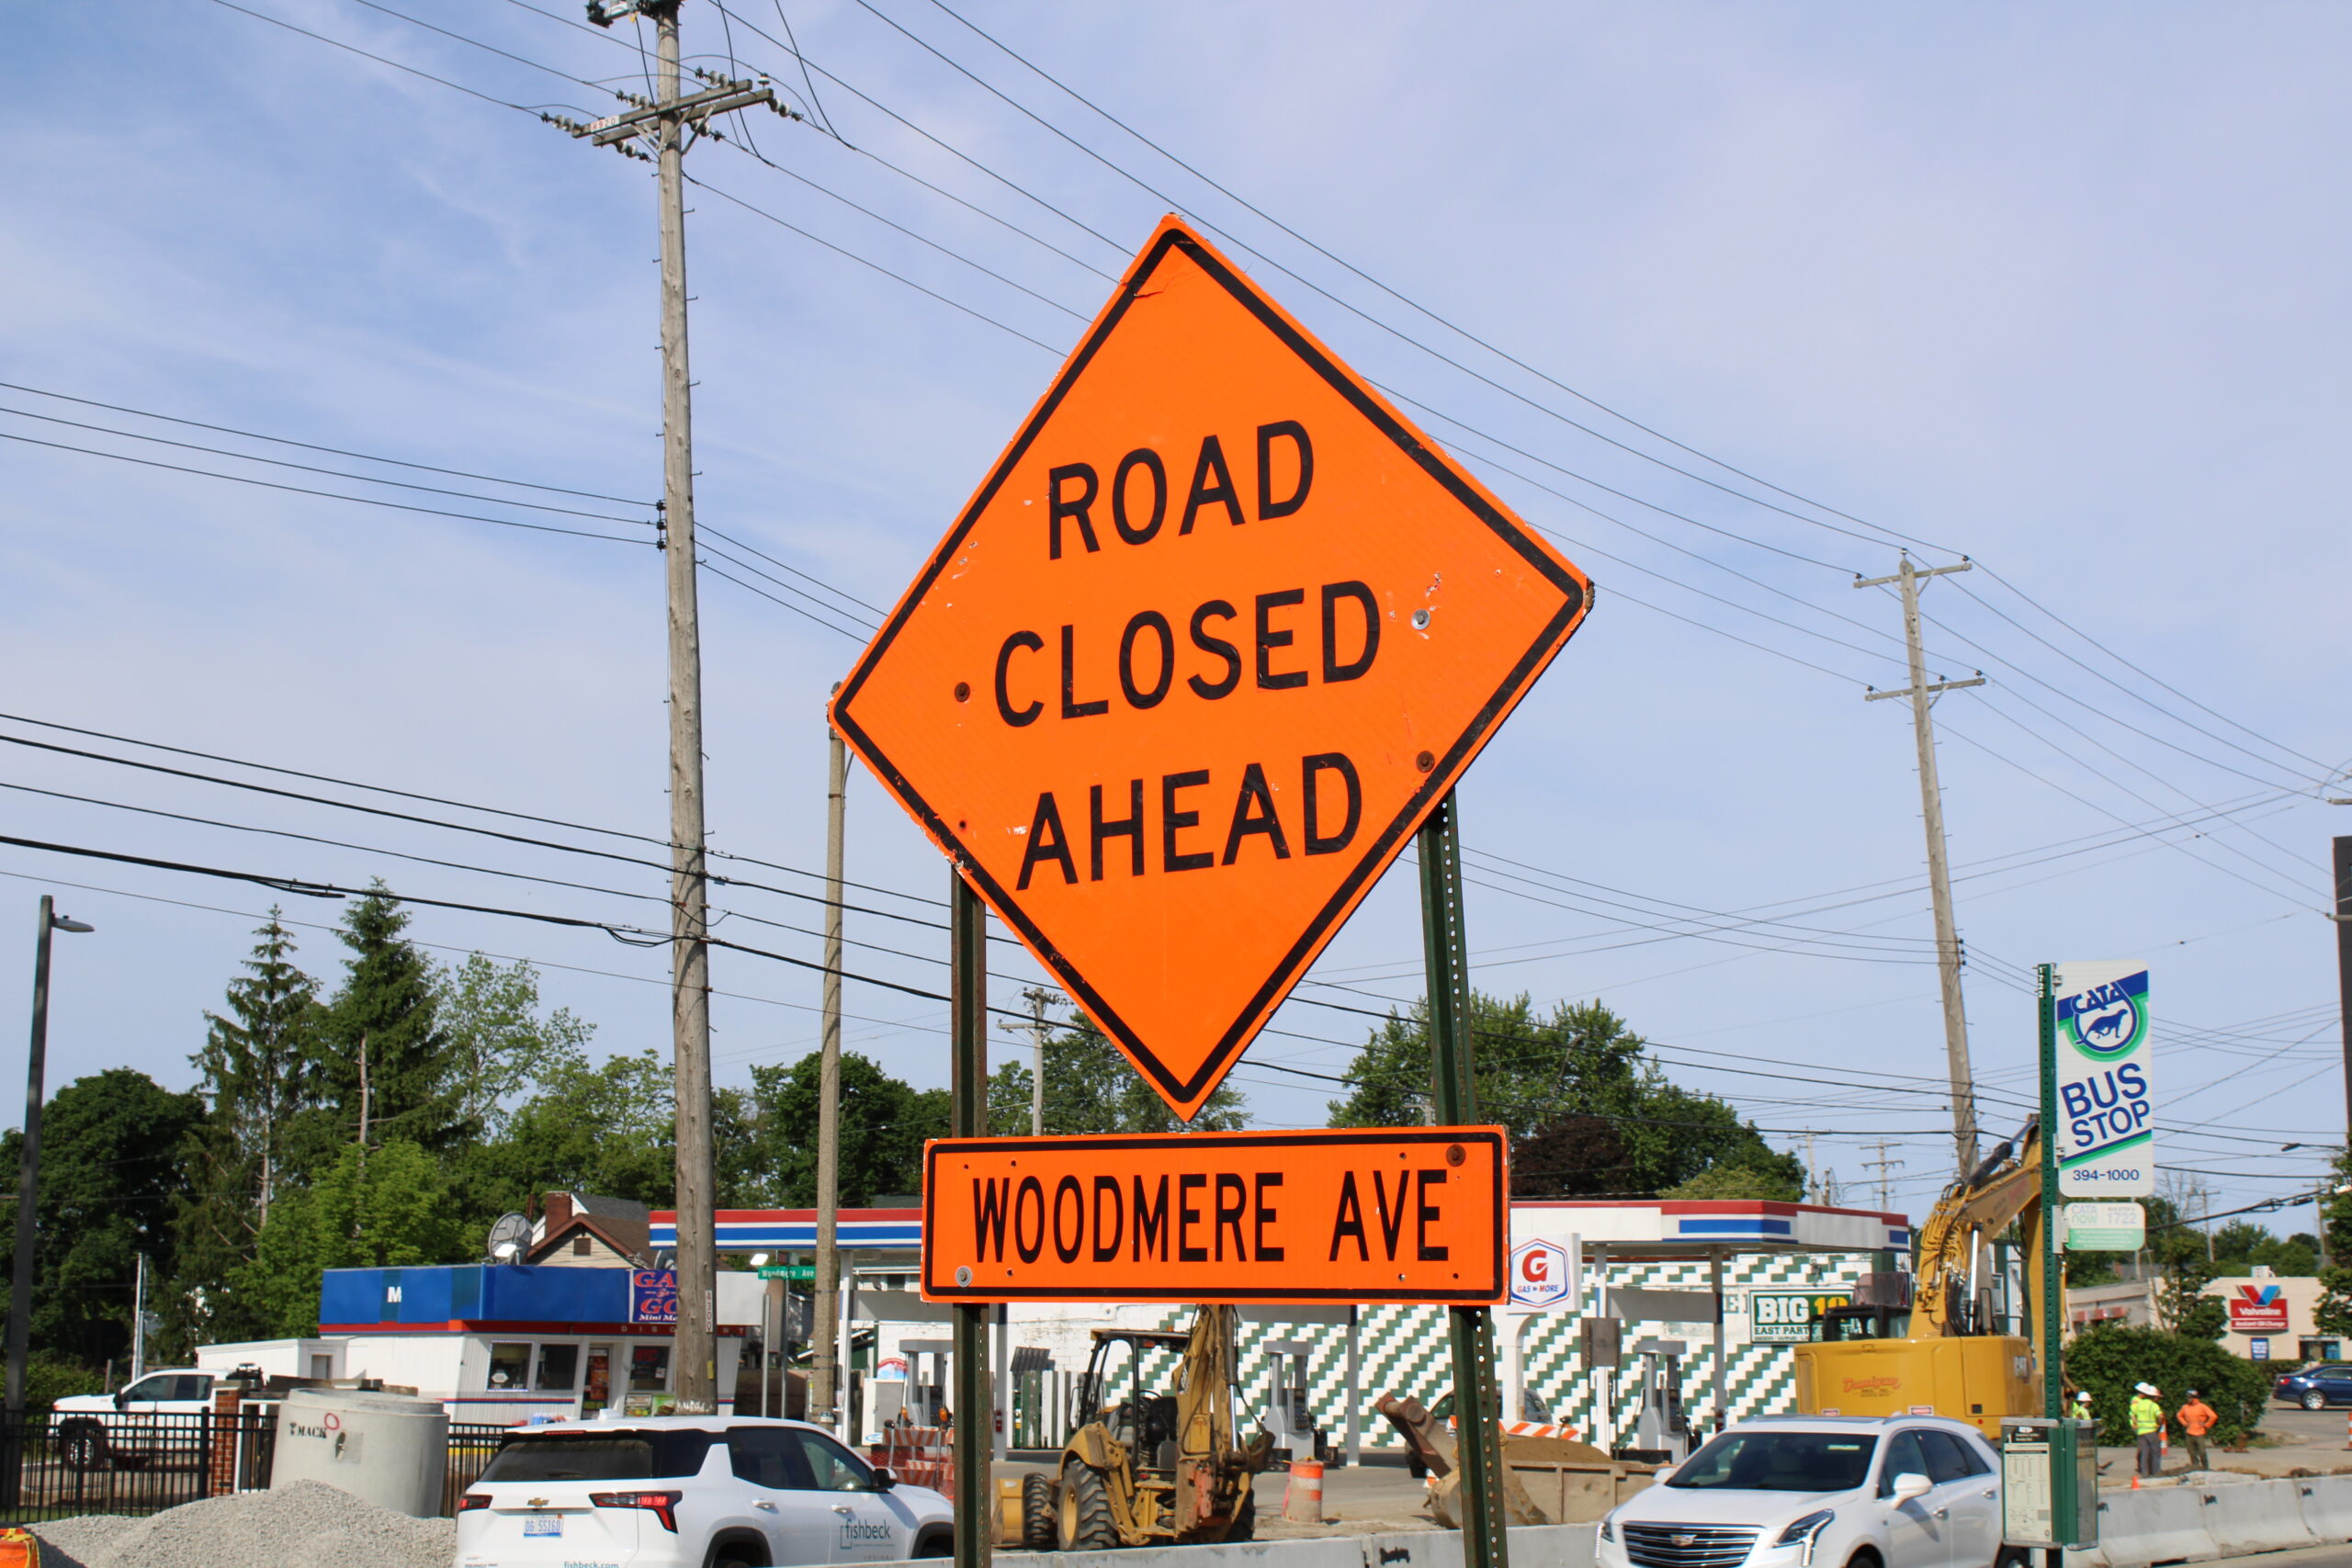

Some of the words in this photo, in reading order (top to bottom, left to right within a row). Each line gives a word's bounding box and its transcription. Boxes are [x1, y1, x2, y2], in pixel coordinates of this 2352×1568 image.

[1049, 420, 1314, 559] ROAD
[995, 581, 1380, 728] CLOSED
[1017, 752, 1362, 890] AHEAD
[2071, 981, 2127, 1014] CATA
[2060, 1063, 2147, 1119] BUS
[2071, 1100, 2151, 1147] STOP
[2073, 1169, 2140, 1181] 394-1000
[973, 1172, 1284, 1264] WOODMERE
[1329, 1169, 1448, 1261] AVE
[802, 1269, 814, 1277] Ave
[1521, 1249, 1548, 1282] G
[634, 1272, 677, 1288] GA
[1539, 1284, 1559, 1292] MORE
[388, 1286, 401, 1303] M
[1756, 1296, 1809, 1324] BIG
[2238, 1308, 2282, 1316] Valvoline
[1754, 1326, 1781, 1336] EAST
[845, 1518, 891, 1540] fishbeck
